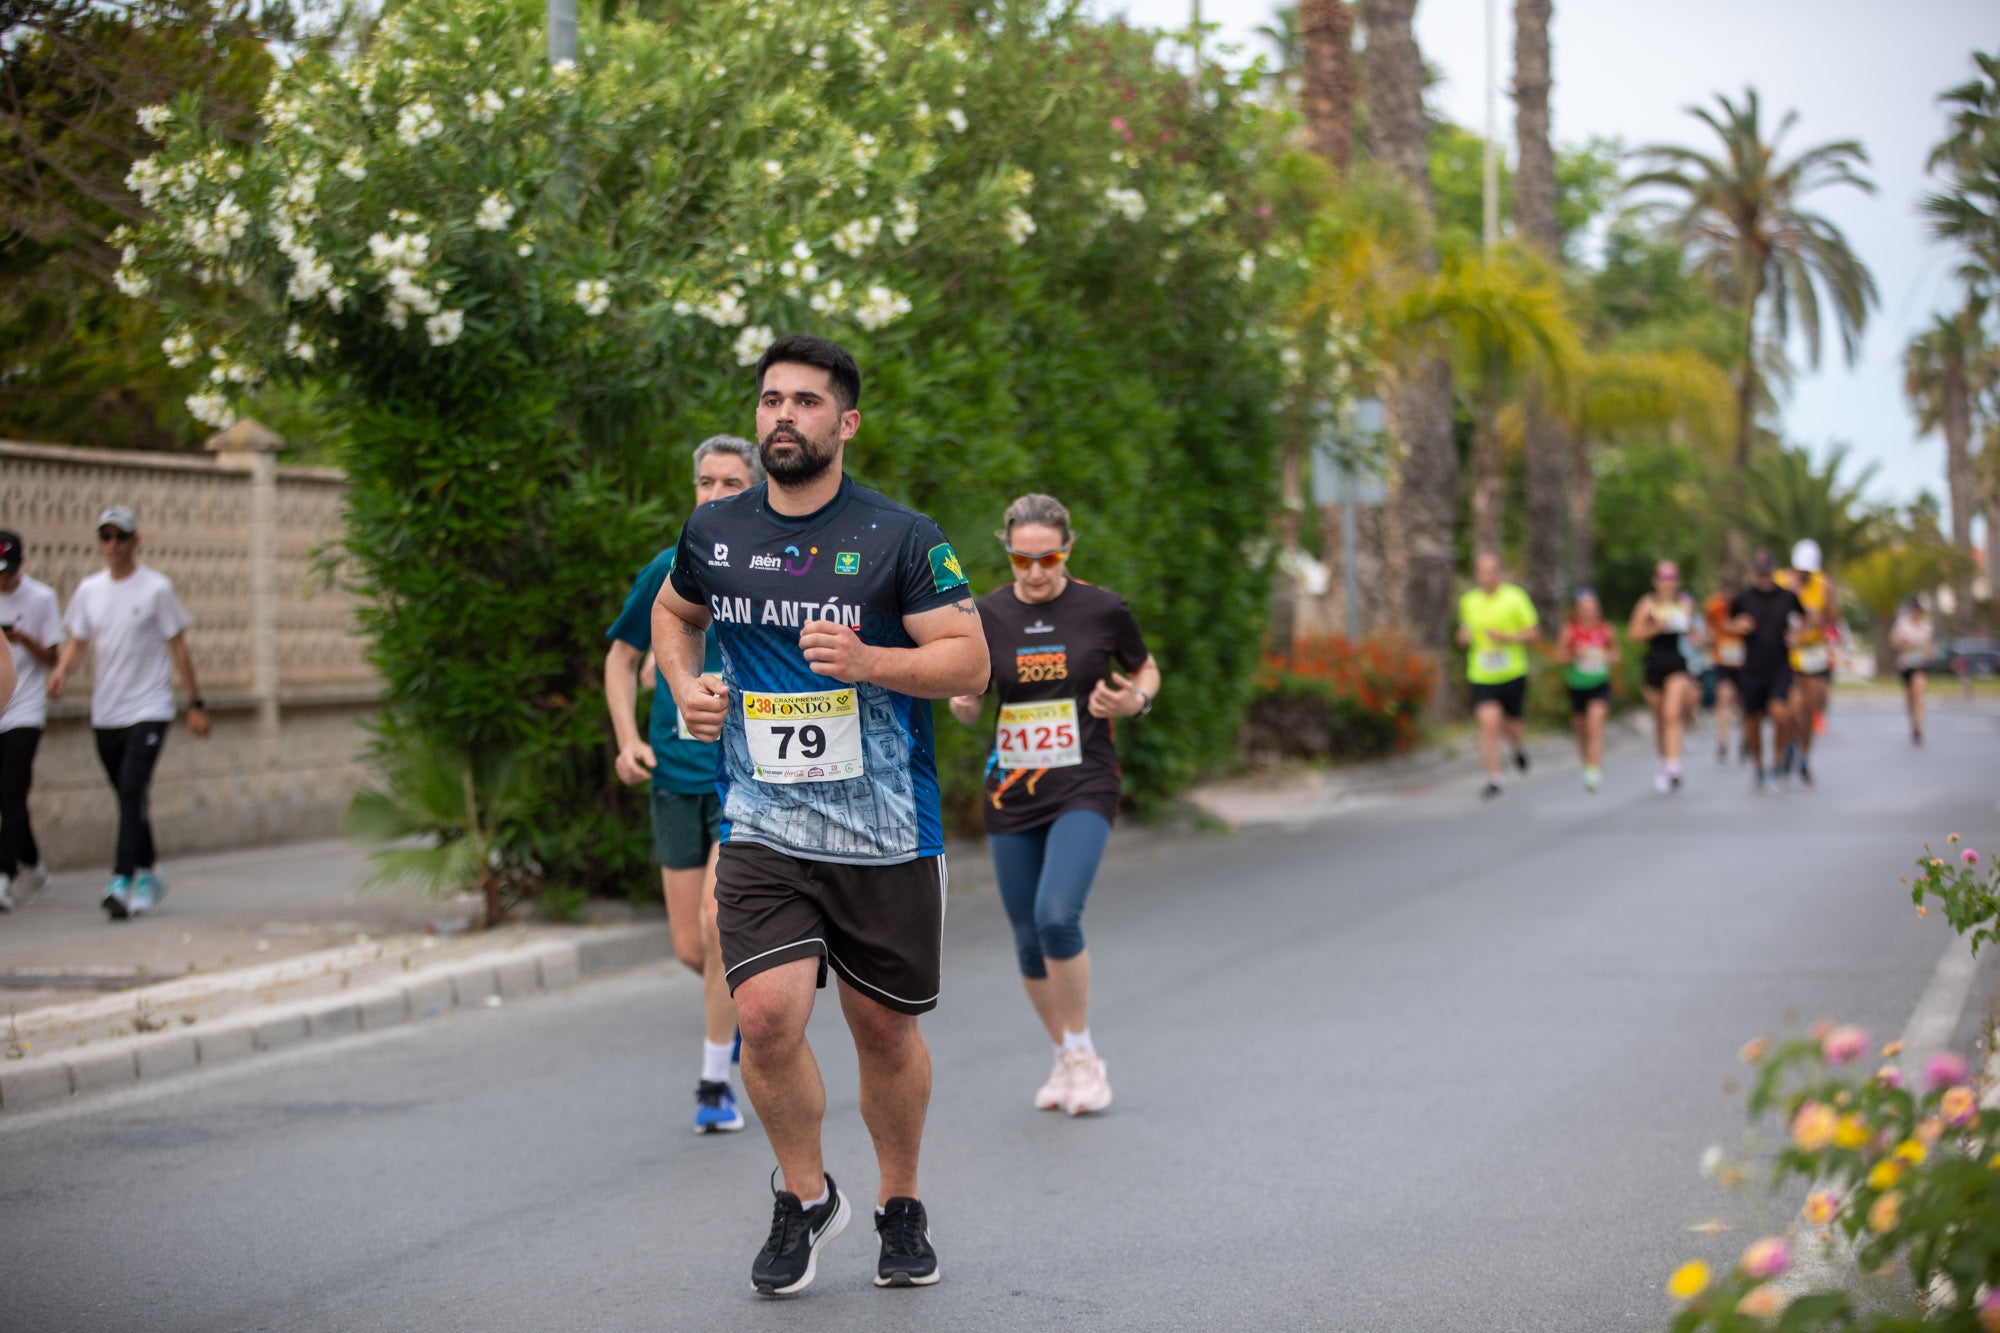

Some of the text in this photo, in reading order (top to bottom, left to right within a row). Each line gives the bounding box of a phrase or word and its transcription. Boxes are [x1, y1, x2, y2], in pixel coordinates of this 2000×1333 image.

[711, 594, 861, 631] SAN ANTÓN
[1016, 652, 1067, 667] FONDO
[1017, 663, 1068, 683] 2025
[756, 698, 771, 714] 38
[796, 695, 825, 703] PREMIO
[771, 724, 826, 760] 79
[999, 723, 1074, 752] 2125
